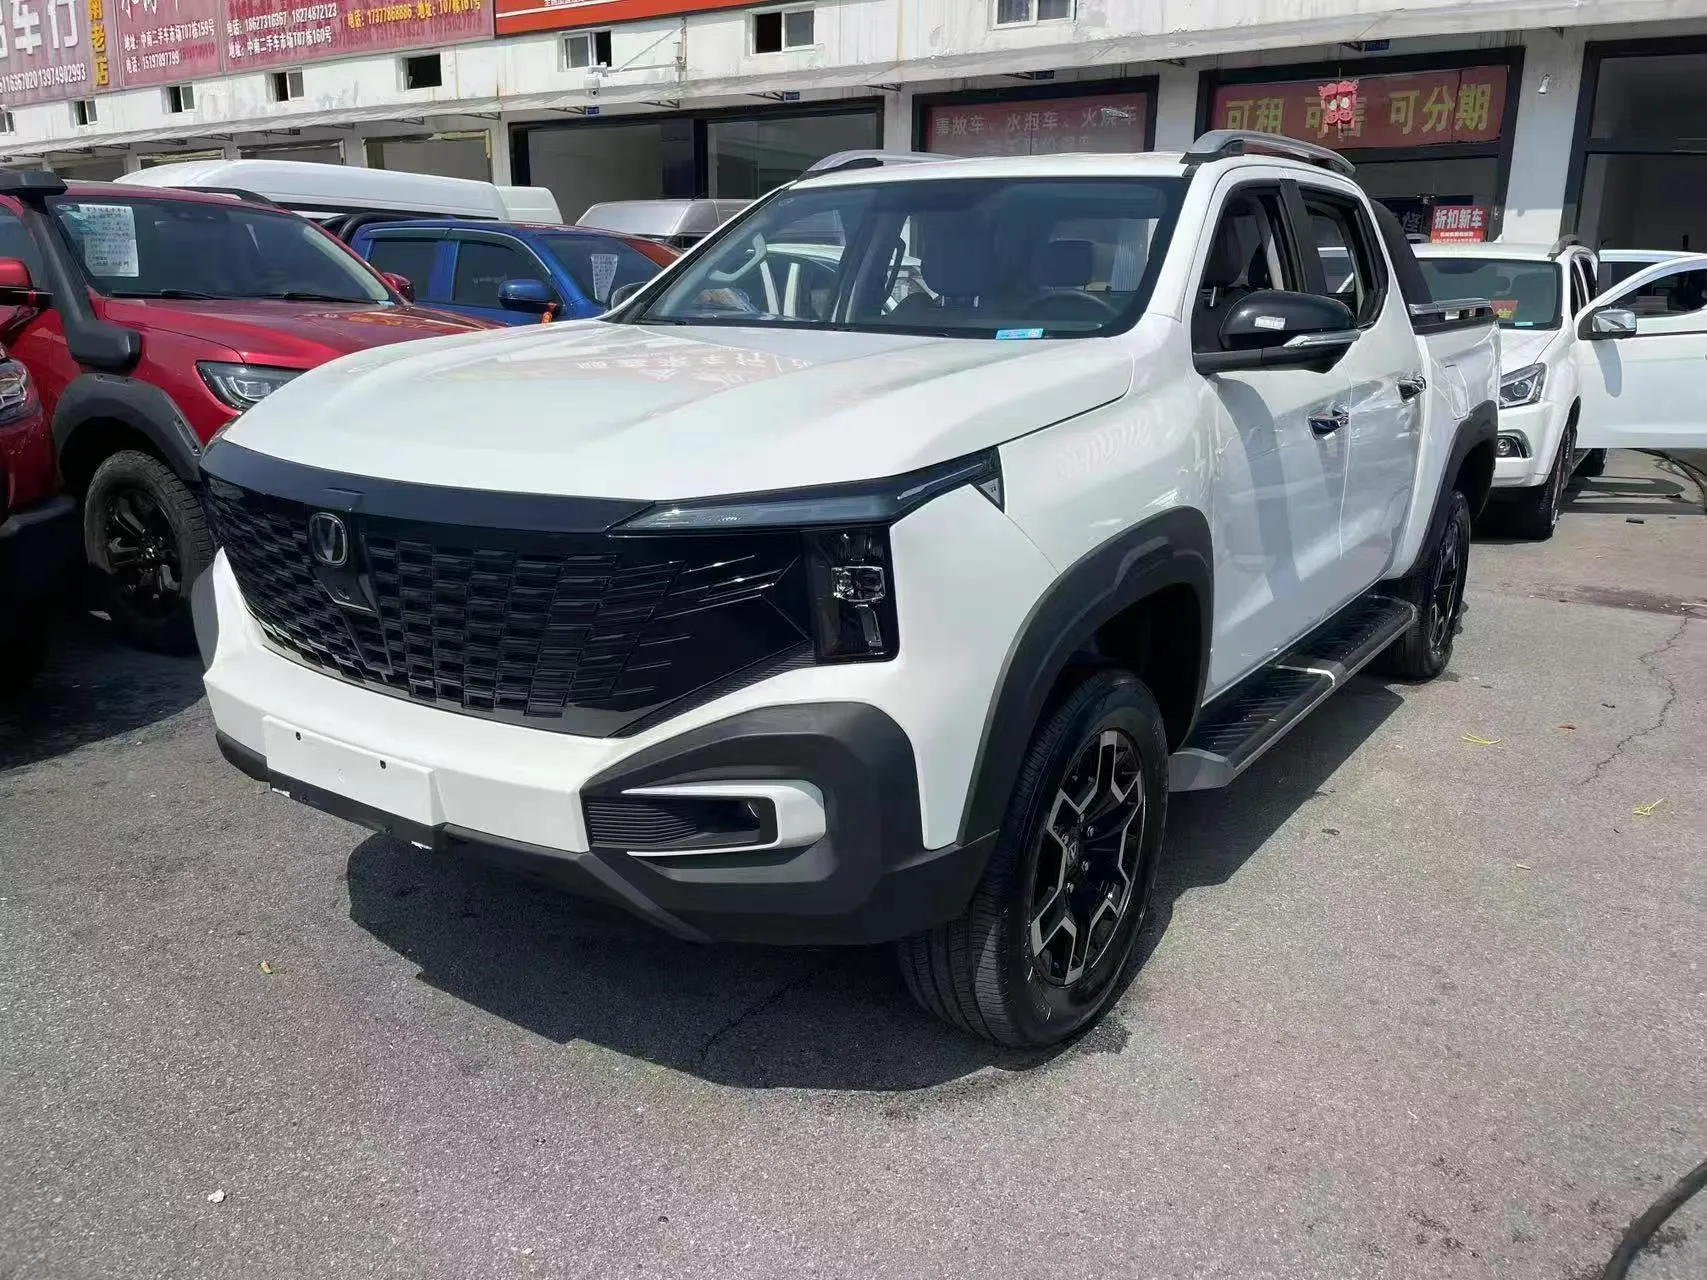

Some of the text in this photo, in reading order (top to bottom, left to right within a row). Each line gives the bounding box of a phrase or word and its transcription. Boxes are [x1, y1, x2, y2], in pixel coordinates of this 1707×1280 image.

[0, 0, 78, 58] 车行
[1390, 84, 1493, 134] 可分期
[1435, 208, 1483, 229] 折扣新车
